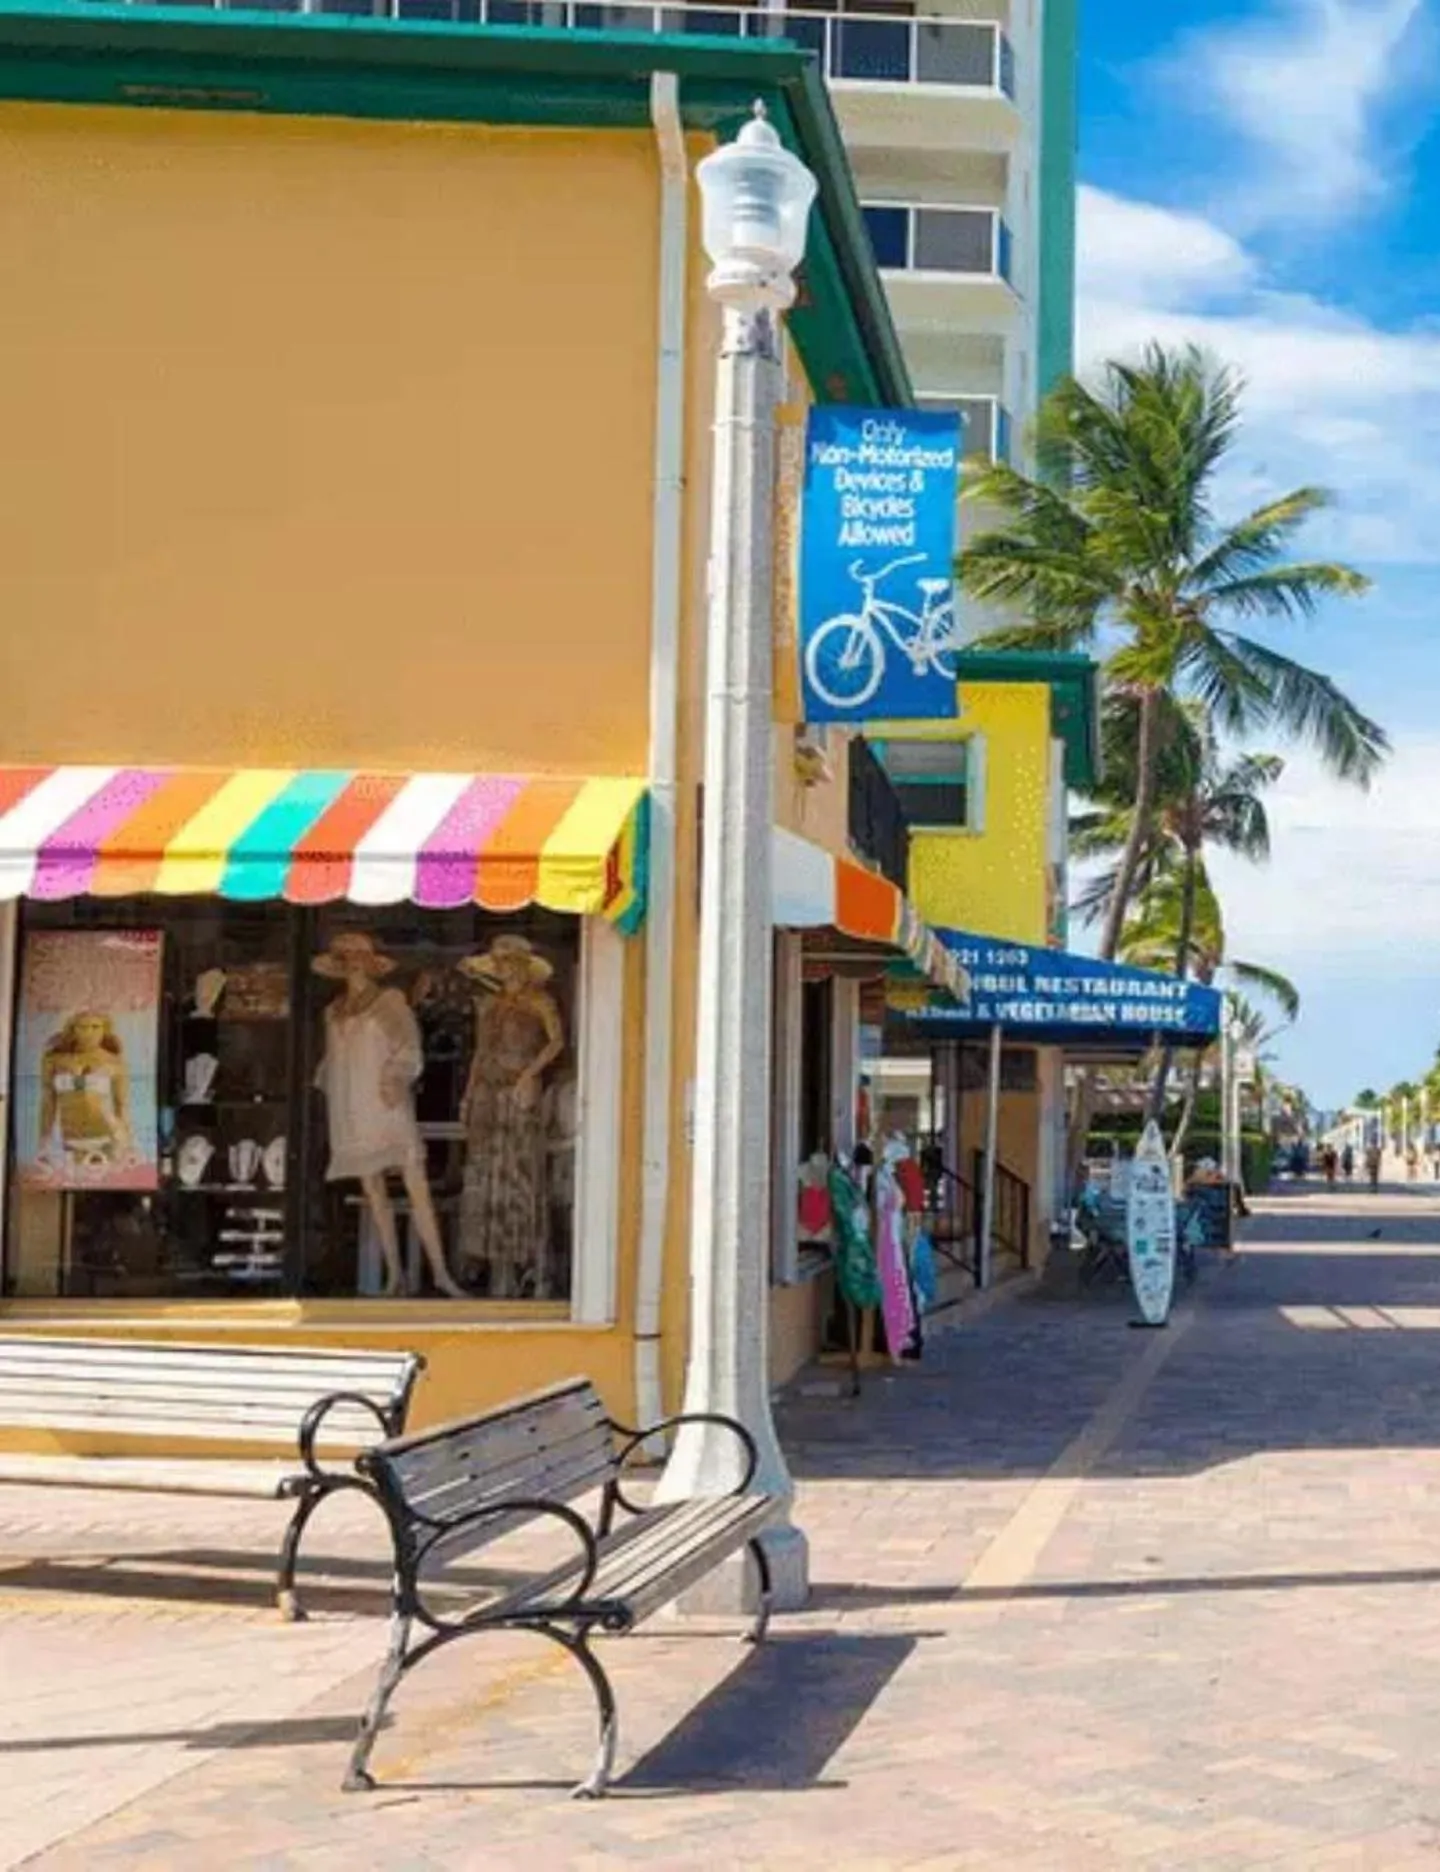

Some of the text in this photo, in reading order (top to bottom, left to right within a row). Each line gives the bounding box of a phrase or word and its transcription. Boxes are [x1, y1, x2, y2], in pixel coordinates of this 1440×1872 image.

[811, 441, 954, 468] Non-Motorized
[834, 466, 925, 493] Devices &
[841, 494, 915, 521] Bicycles
[837, 519, 915, 547] Allowed
[1034, 975, 1190, 1000] RESTAURANT
[996, 1001, 1116, 1023] VEGETARIAN
[1120, 1003, 1188, 1028] HOUSE
